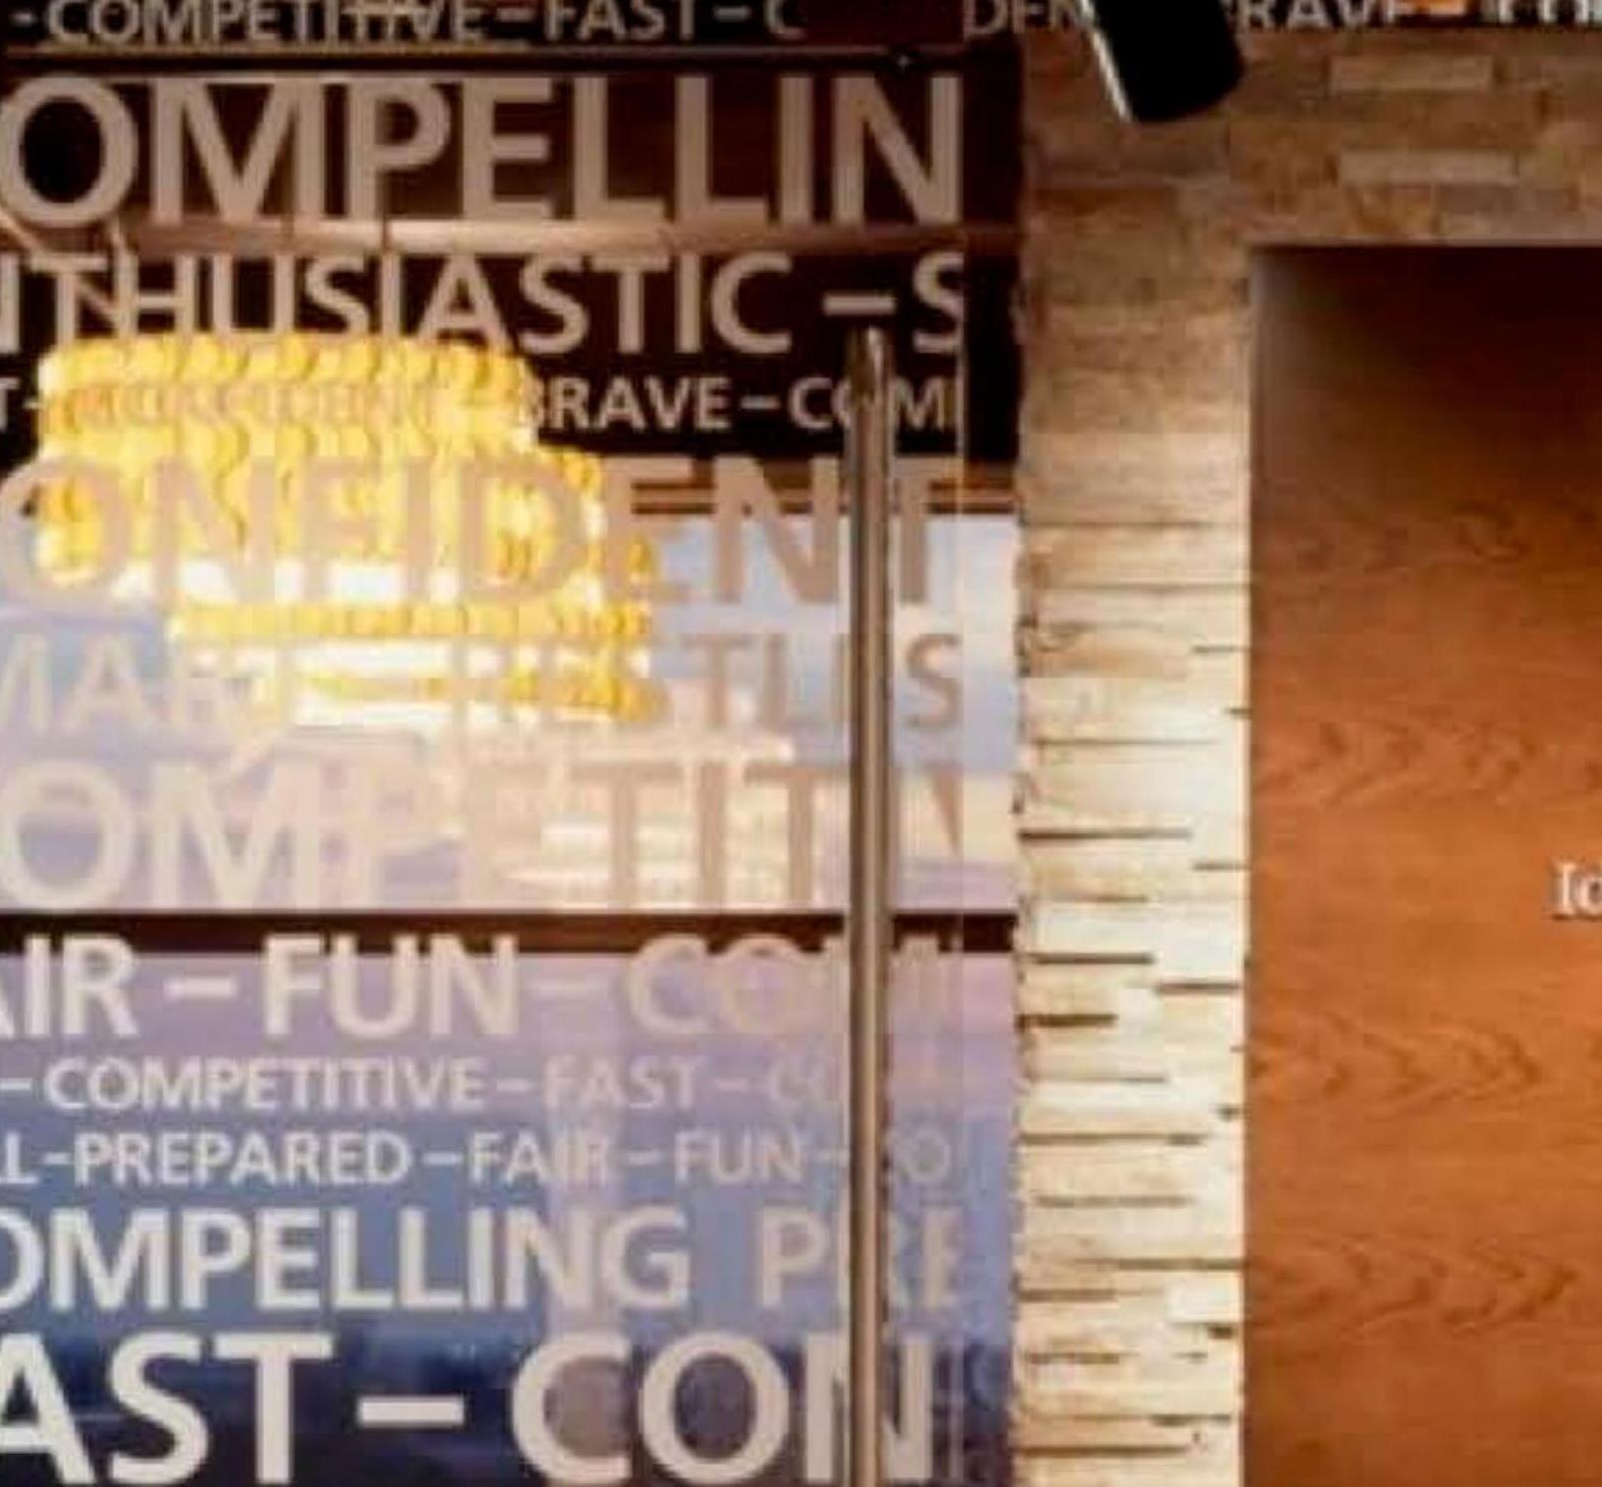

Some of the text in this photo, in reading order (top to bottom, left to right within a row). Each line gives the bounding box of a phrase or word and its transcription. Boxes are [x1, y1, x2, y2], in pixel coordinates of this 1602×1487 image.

[262, 933, 520, 1037] FUN
[44, 1056, 486, 1112] COMPETITIVE
[510, 1330, 934, 1486] CON
